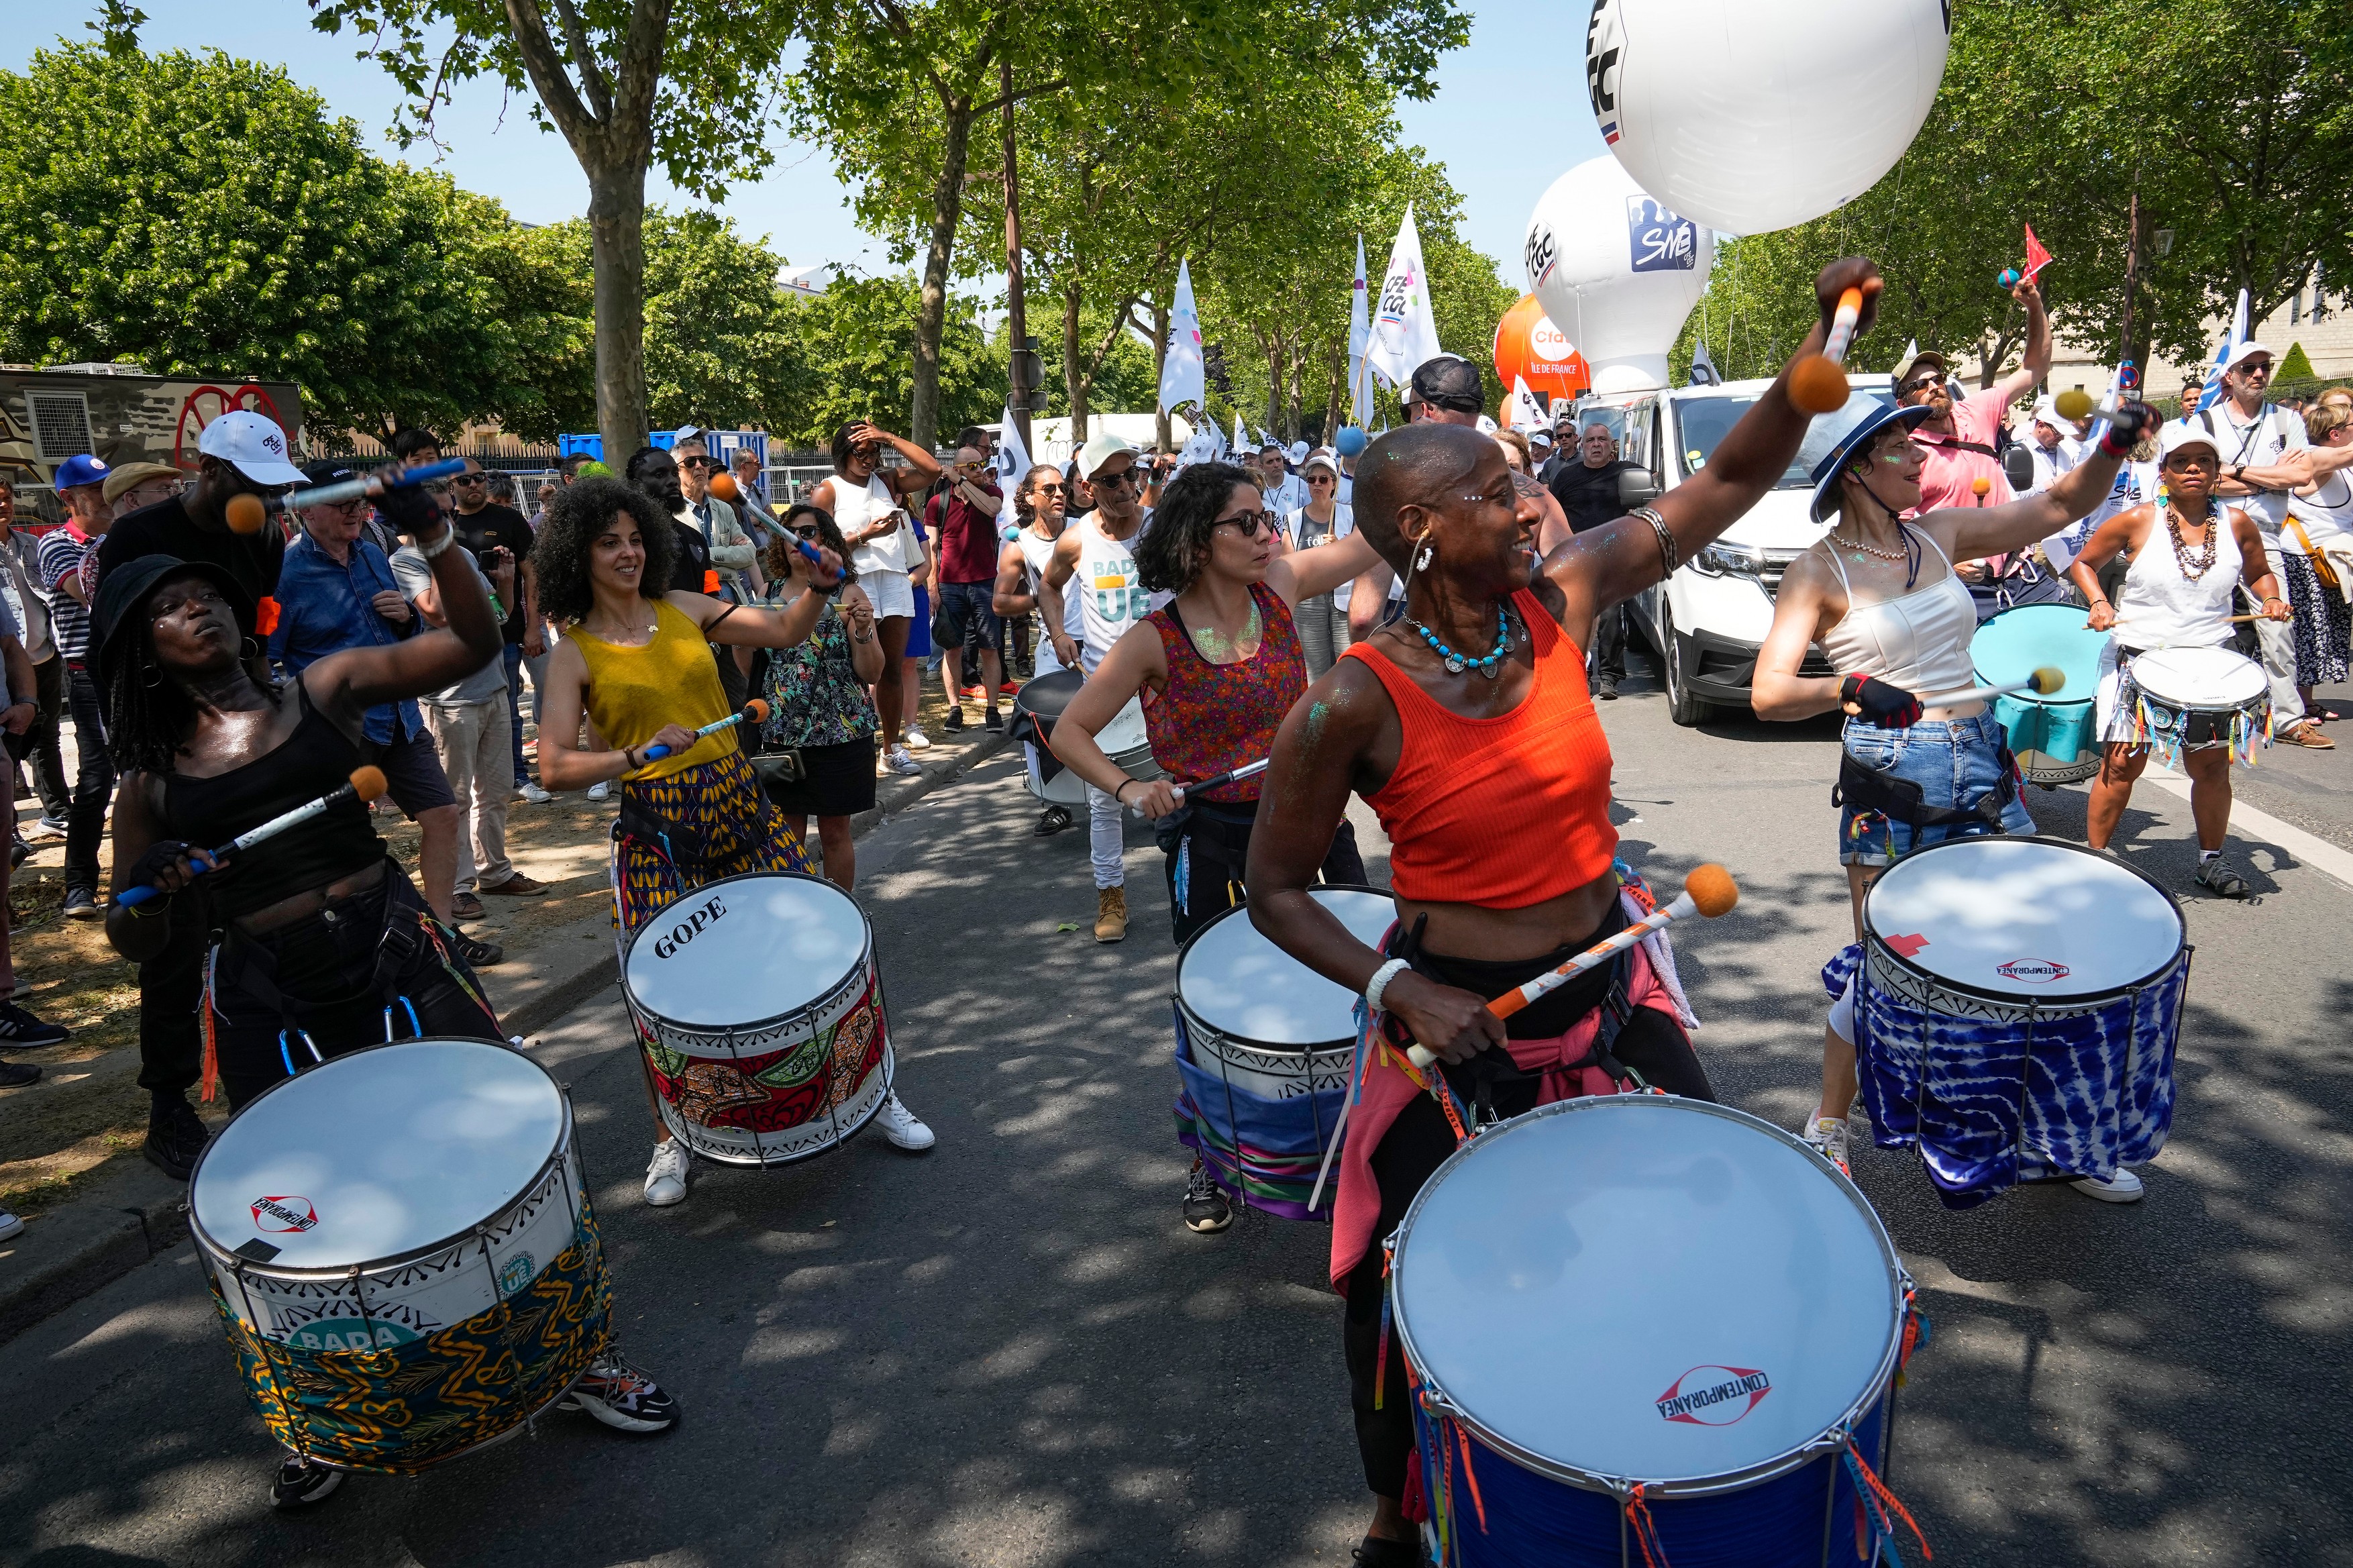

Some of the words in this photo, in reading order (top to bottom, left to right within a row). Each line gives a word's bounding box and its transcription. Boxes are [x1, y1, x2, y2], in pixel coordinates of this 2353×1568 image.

[1524, 223, 1539, 268] CFE
[1531, 232, 1553, 278] CGC
[1385, 276, 1408, 294] CFE
[1531, 362, 1540, 374] ÎLE
[1541, 364, 1551, 374] DE
[1551, 364, 1577, 374] FRANCE
[262, 435, 274, 447] CFE
[1093, 559, 1138, 576] BAD
[654, 896, 727, 959] GOPE
[504, 1259, 525, 1277] BADA
[299, 1326, 401, 1351] BADA
[1656, 1372, 1770, 1418] CONTEMPORÂNEA
[1850, 1461, 1860, 1475] DO
